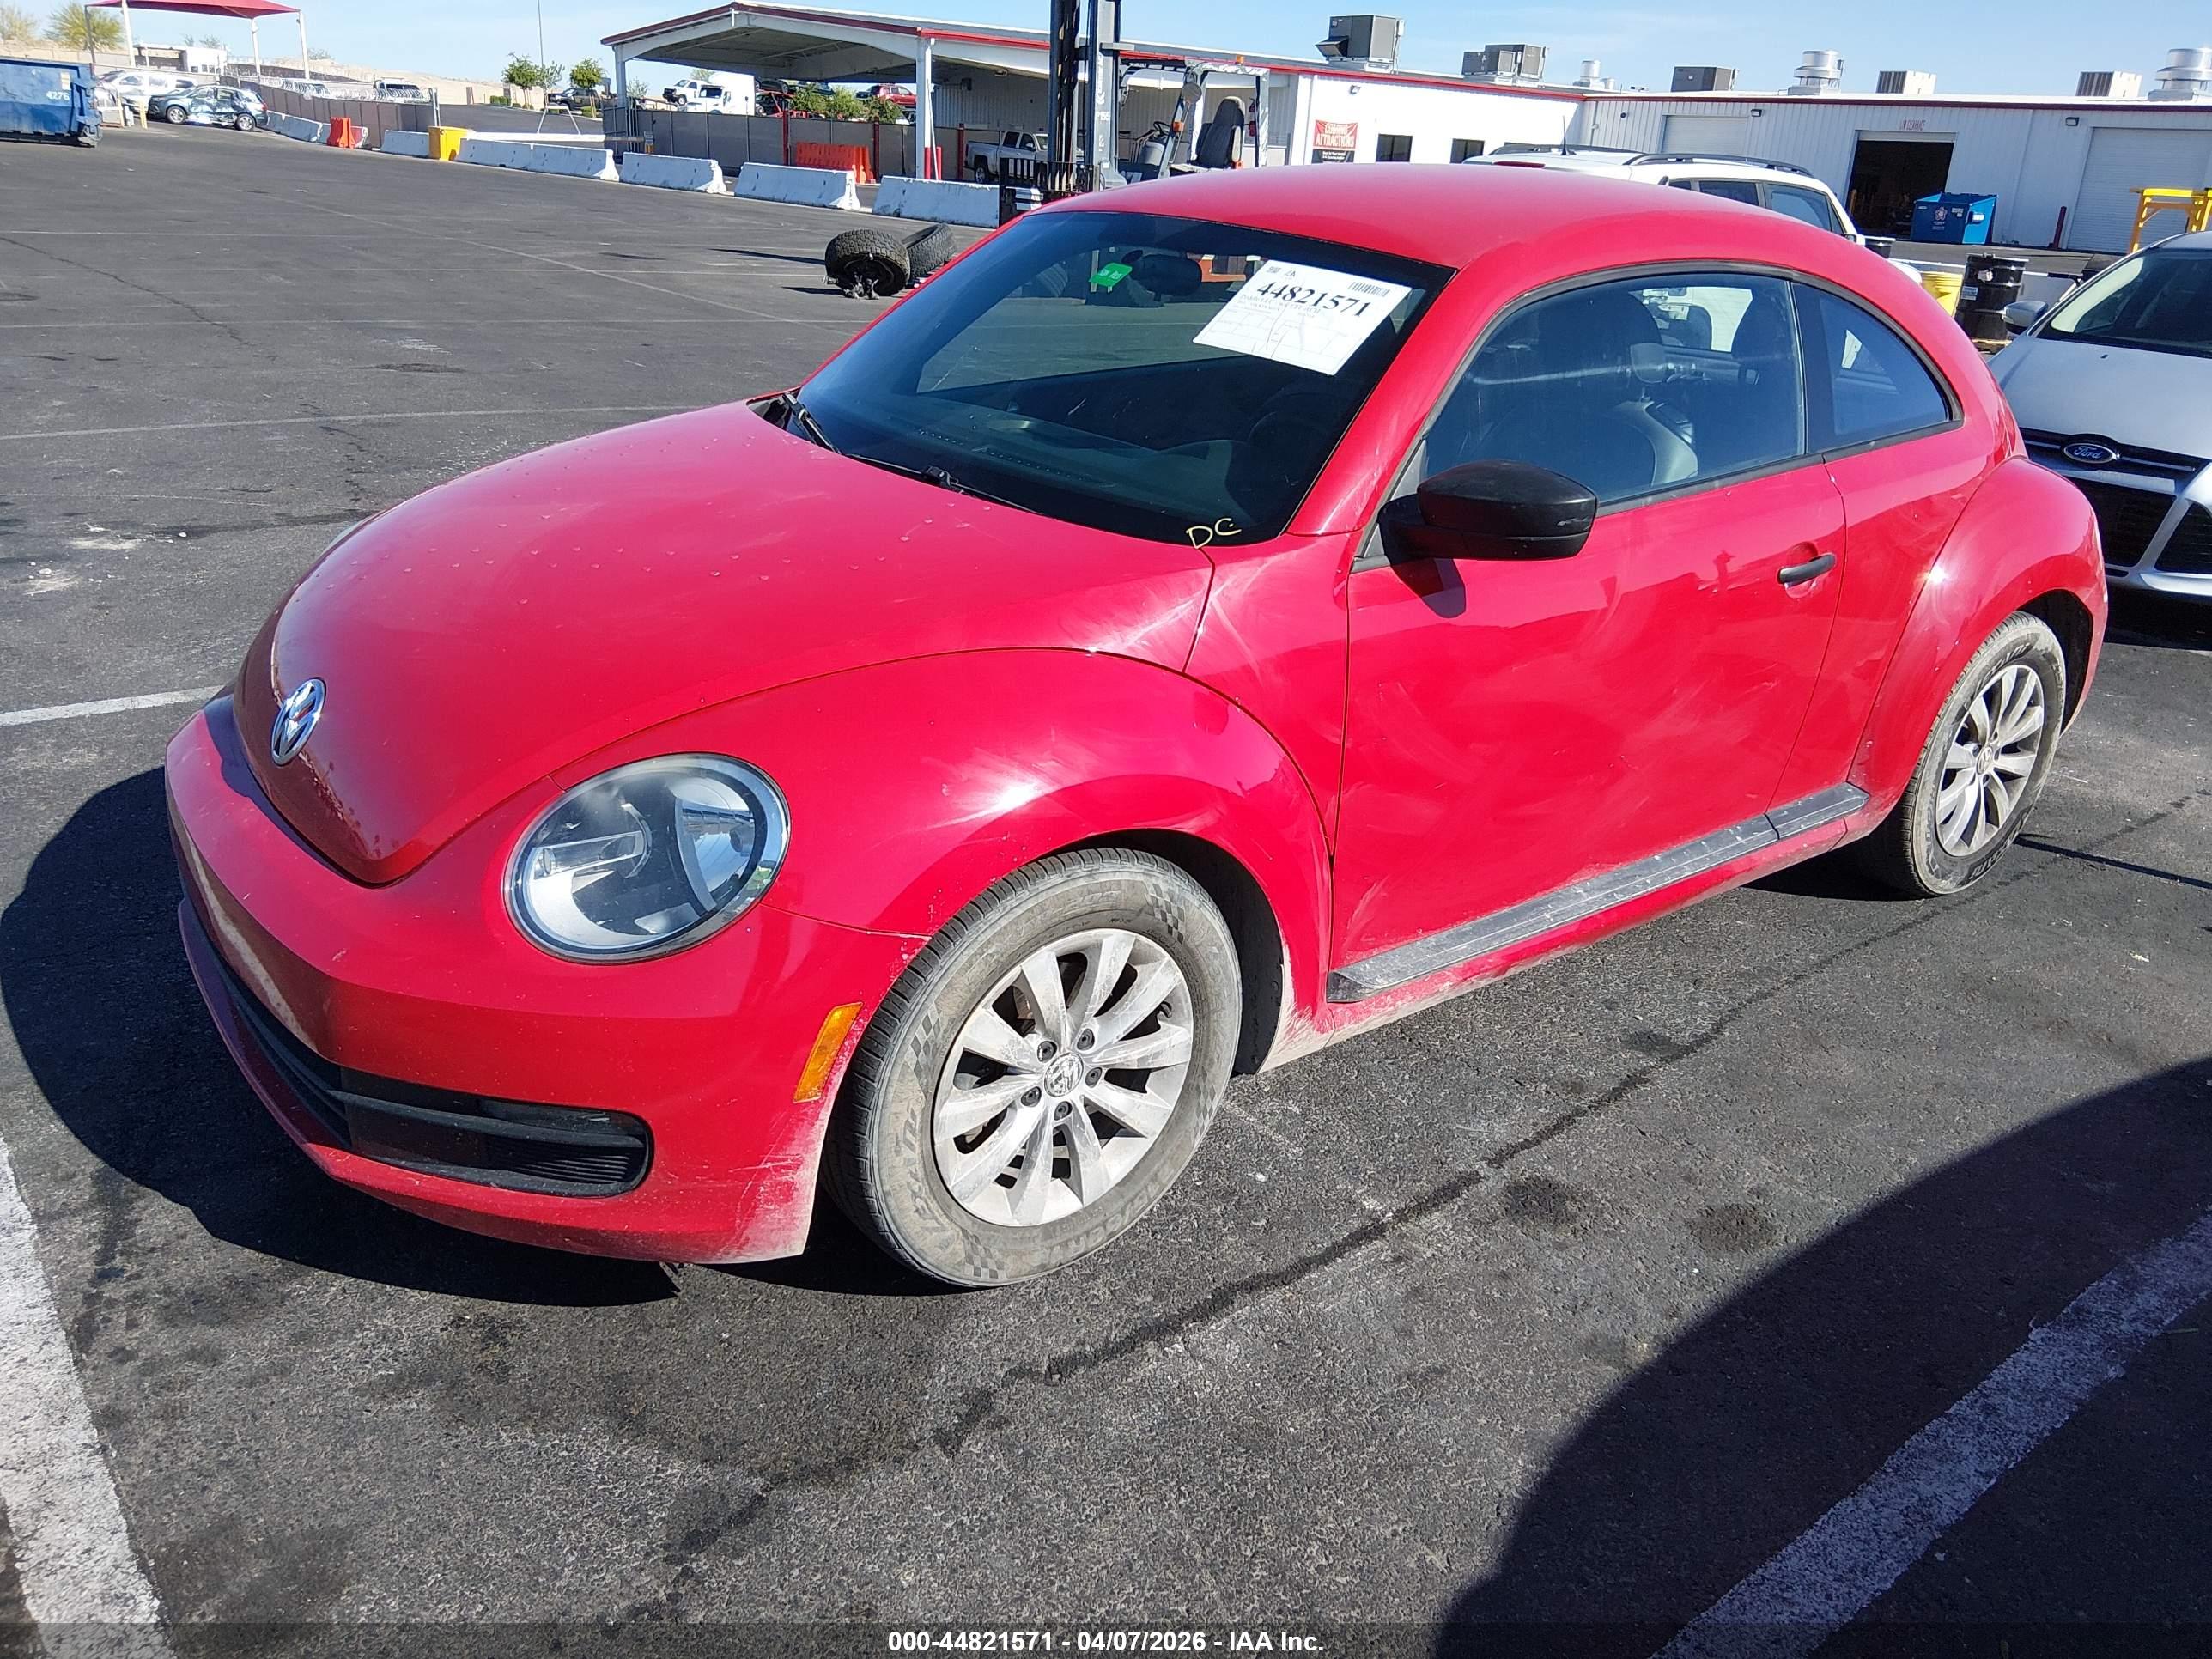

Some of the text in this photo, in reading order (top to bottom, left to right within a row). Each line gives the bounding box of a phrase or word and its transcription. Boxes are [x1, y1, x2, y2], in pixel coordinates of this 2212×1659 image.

[1315, 134, 1354, 148] ATTRACTIONS
[1257, 281, 1371, 317] 44821571
[2074, 446, 2102, 459] Ford
